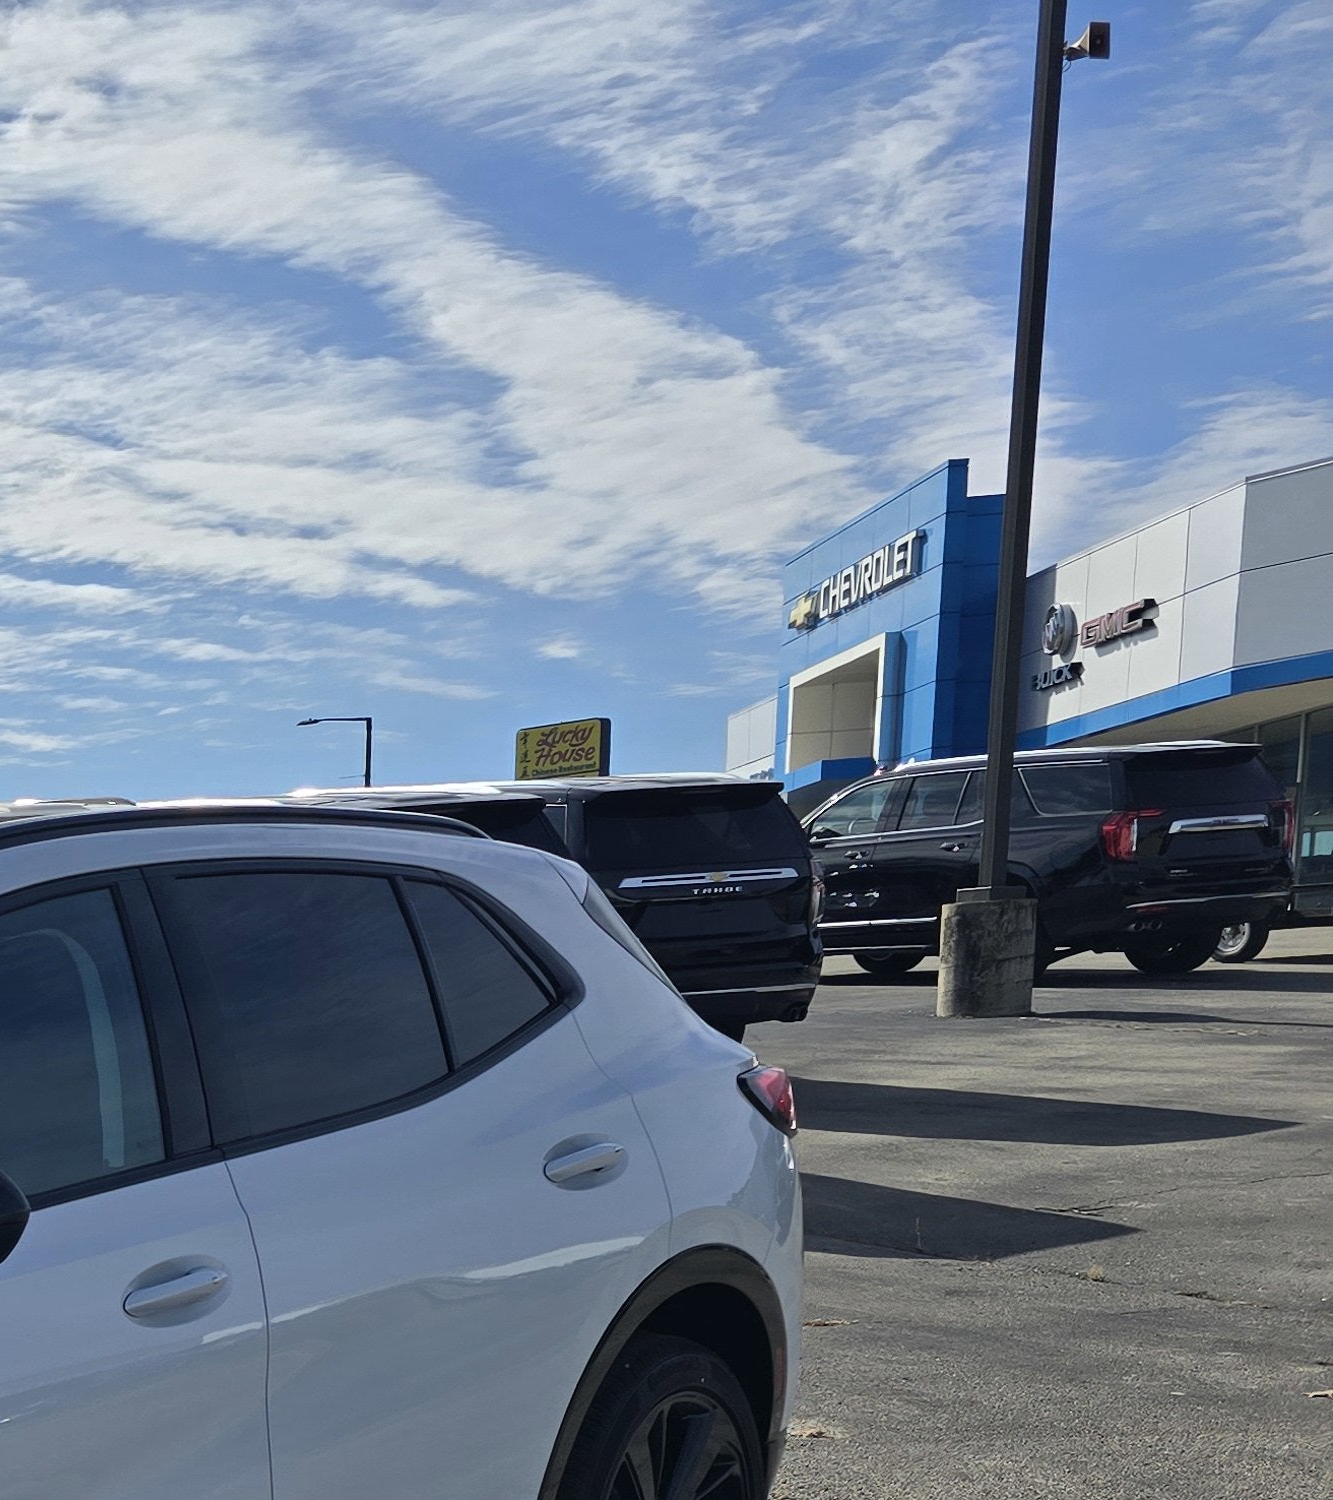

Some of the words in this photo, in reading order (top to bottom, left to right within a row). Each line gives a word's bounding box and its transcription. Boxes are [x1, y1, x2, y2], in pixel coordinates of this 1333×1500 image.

[819, 530, 917, 619] CHEVROLET
[1080, 599, 1146, 649] GMC
[536, 725, 595, 748] Lucky
[534, 746, 596, 767] House
[693, 886, 742, 895] TAHOE
